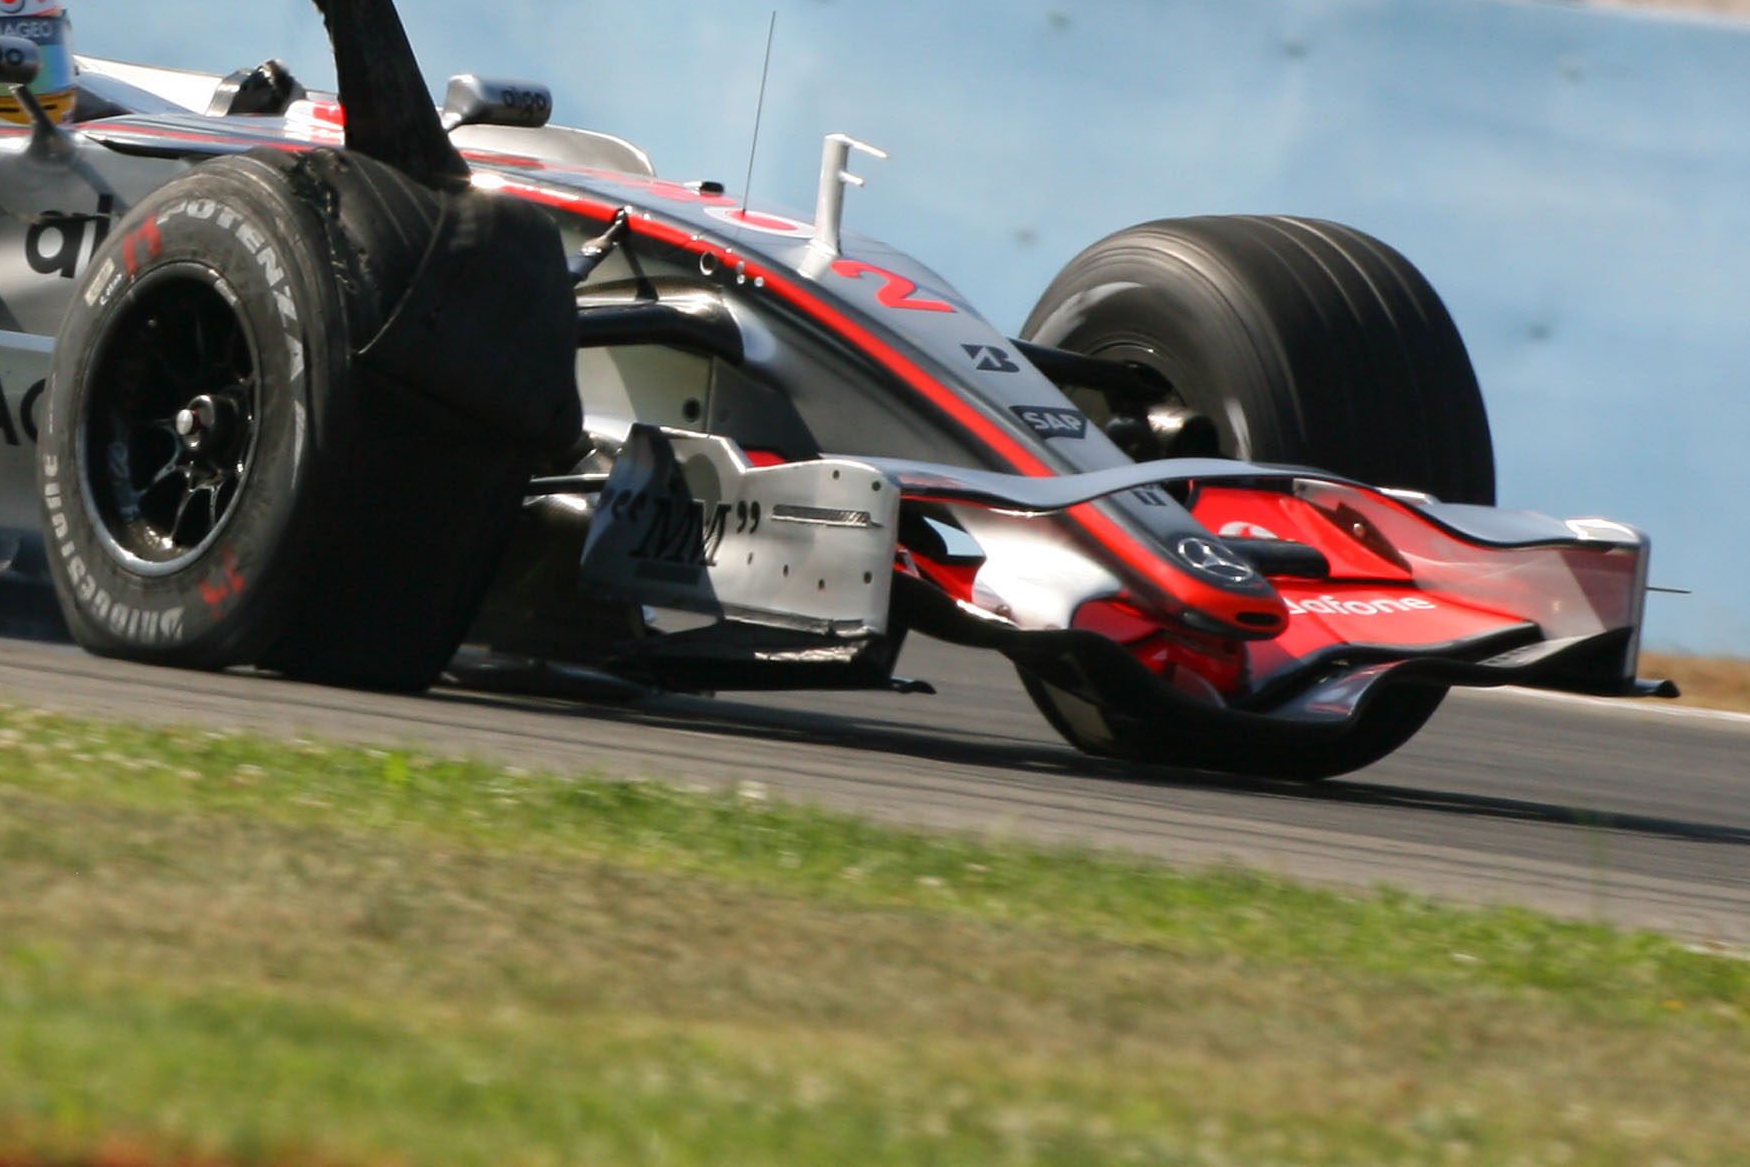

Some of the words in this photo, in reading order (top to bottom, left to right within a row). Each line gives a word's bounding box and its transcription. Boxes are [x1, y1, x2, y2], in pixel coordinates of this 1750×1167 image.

[156, 198, 307, 383] POTENZA
[830, 258, 958, 314] 2
[1022, 412, 1082, 431] SAP
